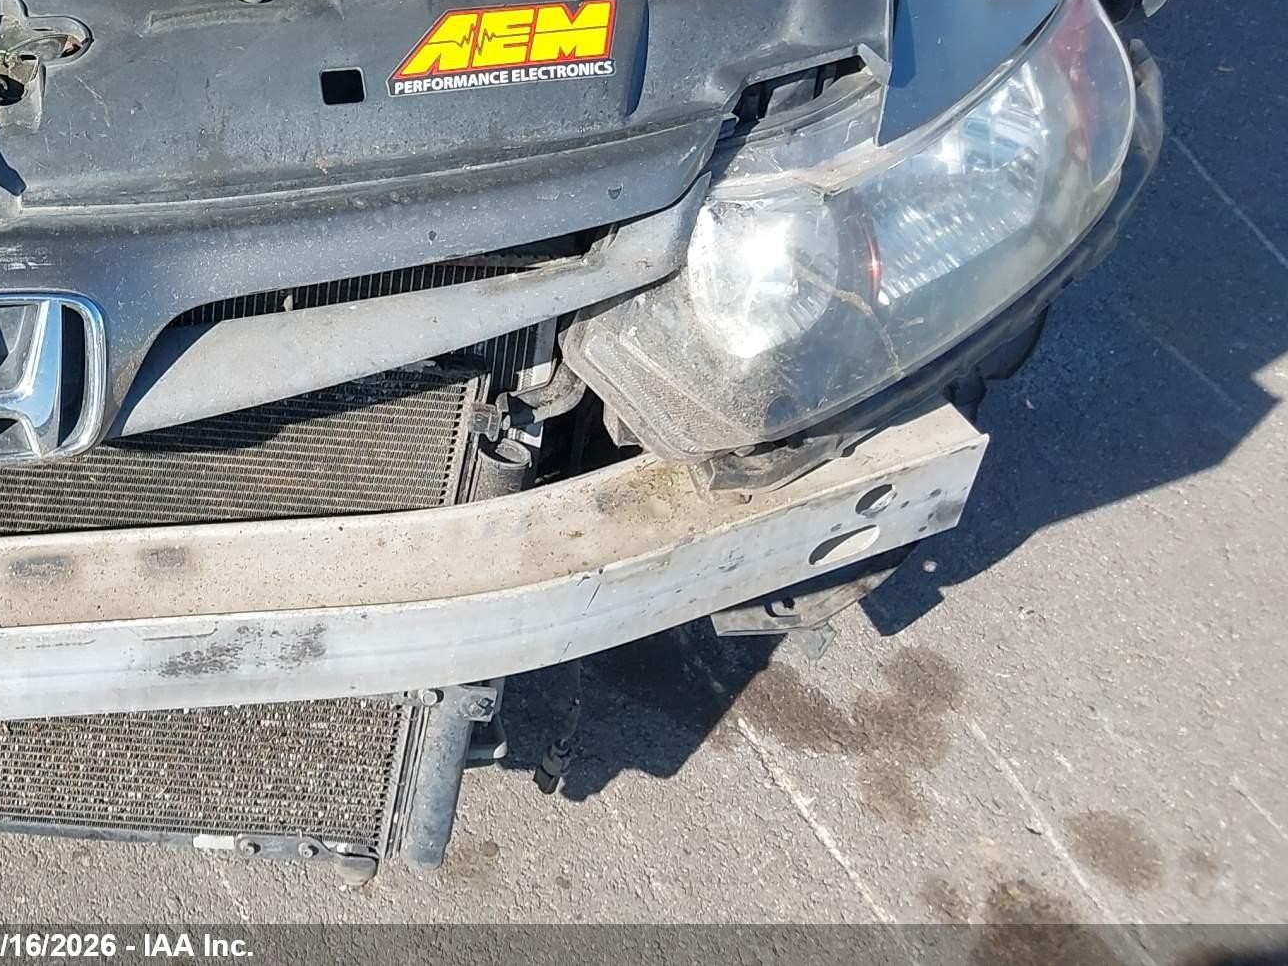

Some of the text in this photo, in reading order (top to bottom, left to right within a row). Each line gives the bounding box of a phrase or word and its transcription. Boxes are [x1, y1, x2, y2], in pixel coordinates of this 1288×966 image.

[400, 1, 611, 75] AEM
[394, 60, 614, 95] PERFORMANCE ELECTRONICS
